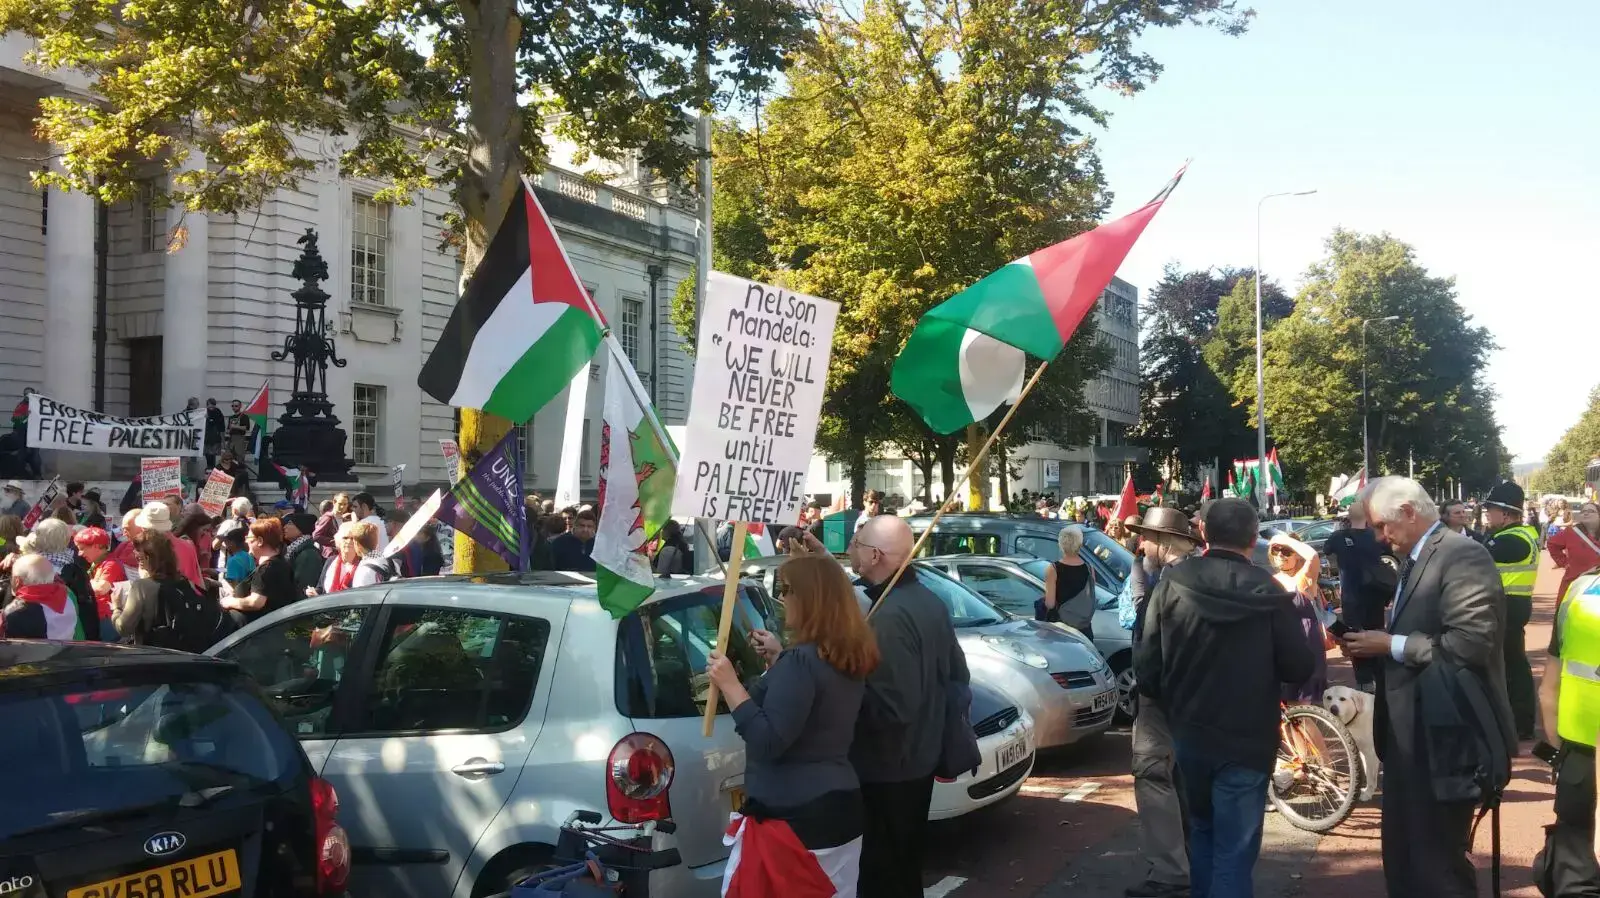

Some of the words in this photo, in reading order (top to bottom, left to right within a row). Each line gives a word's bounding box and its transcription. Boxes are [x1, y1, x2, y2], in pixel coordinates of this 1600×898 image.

[770, 348, 815, 384] WILL
[728, 371, 796, 409] NEVER
[38, 418, 93, 446] FREE
[108, 426, 203, 451] PALESTINE
[717, 402, 745, 431] BE
[748, 407, 798, 438] FREE
[725, 437, 774, 466] until
[694, 461, 804, 502] PALESTINE
[701, 493, 718, 518] is
[151, 834, 180, 853] KIA
[0, 875, 33, 895] nto
[171, 856, 227, 897] RLU
